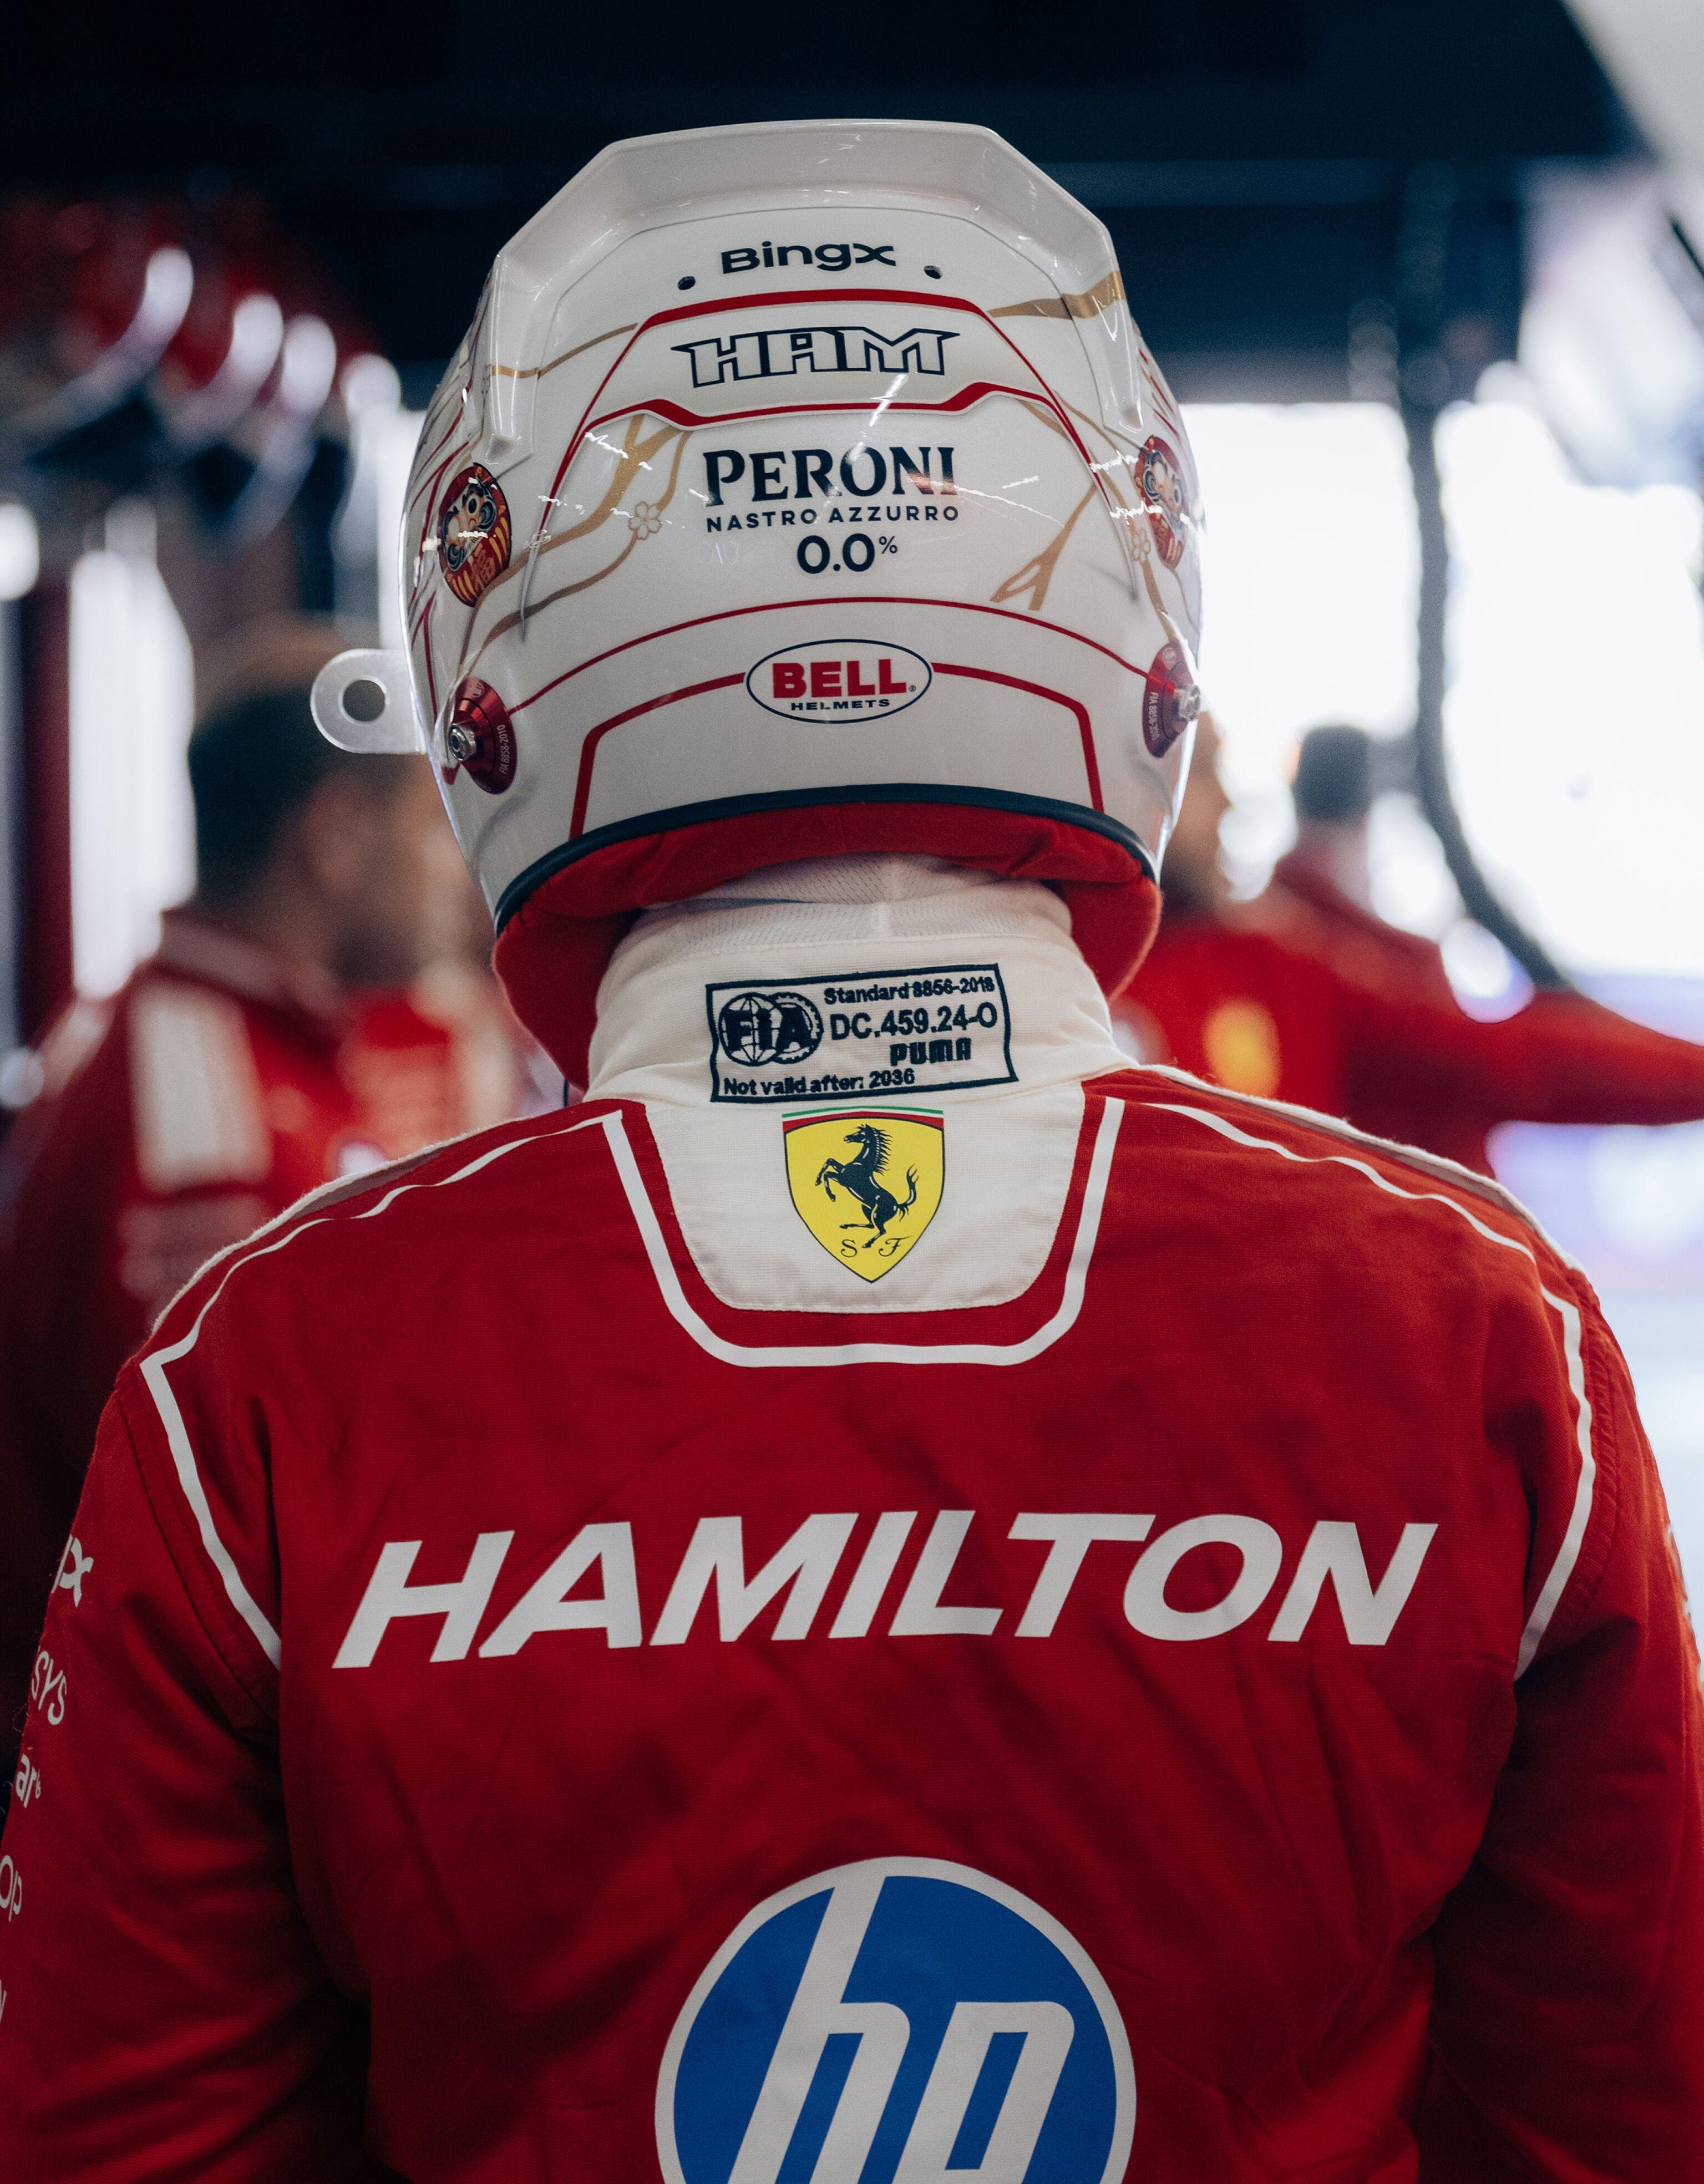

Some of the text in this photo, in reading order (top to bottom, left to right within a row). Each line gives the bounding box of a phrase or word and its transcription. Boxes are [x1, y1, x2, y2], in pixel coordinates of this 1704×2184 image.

[671, 326, 960, 388] HAM
[703, 446, 958, 507] PERONI
[706, 505, 959, 532] NASTRO AZZURRO
[797, 533, 898, 575] 0.0%
[773, 658, 906, 698] BELL
[791, 699, 890, 710] HELMETS
[497, 724, 510, 774] FIA 8858-2010
[823, 976, 995, 1005] Standard 8856-2018
[890, 1038, 972, 1066] PUMA
[724, 1068, 915, 1095] Not valid after: 2036
[840, 1239, 858, 1258] S
[332, 1510, 1439, 1669] HAMILTON
[727, 1875, 1074, 2184] hp
